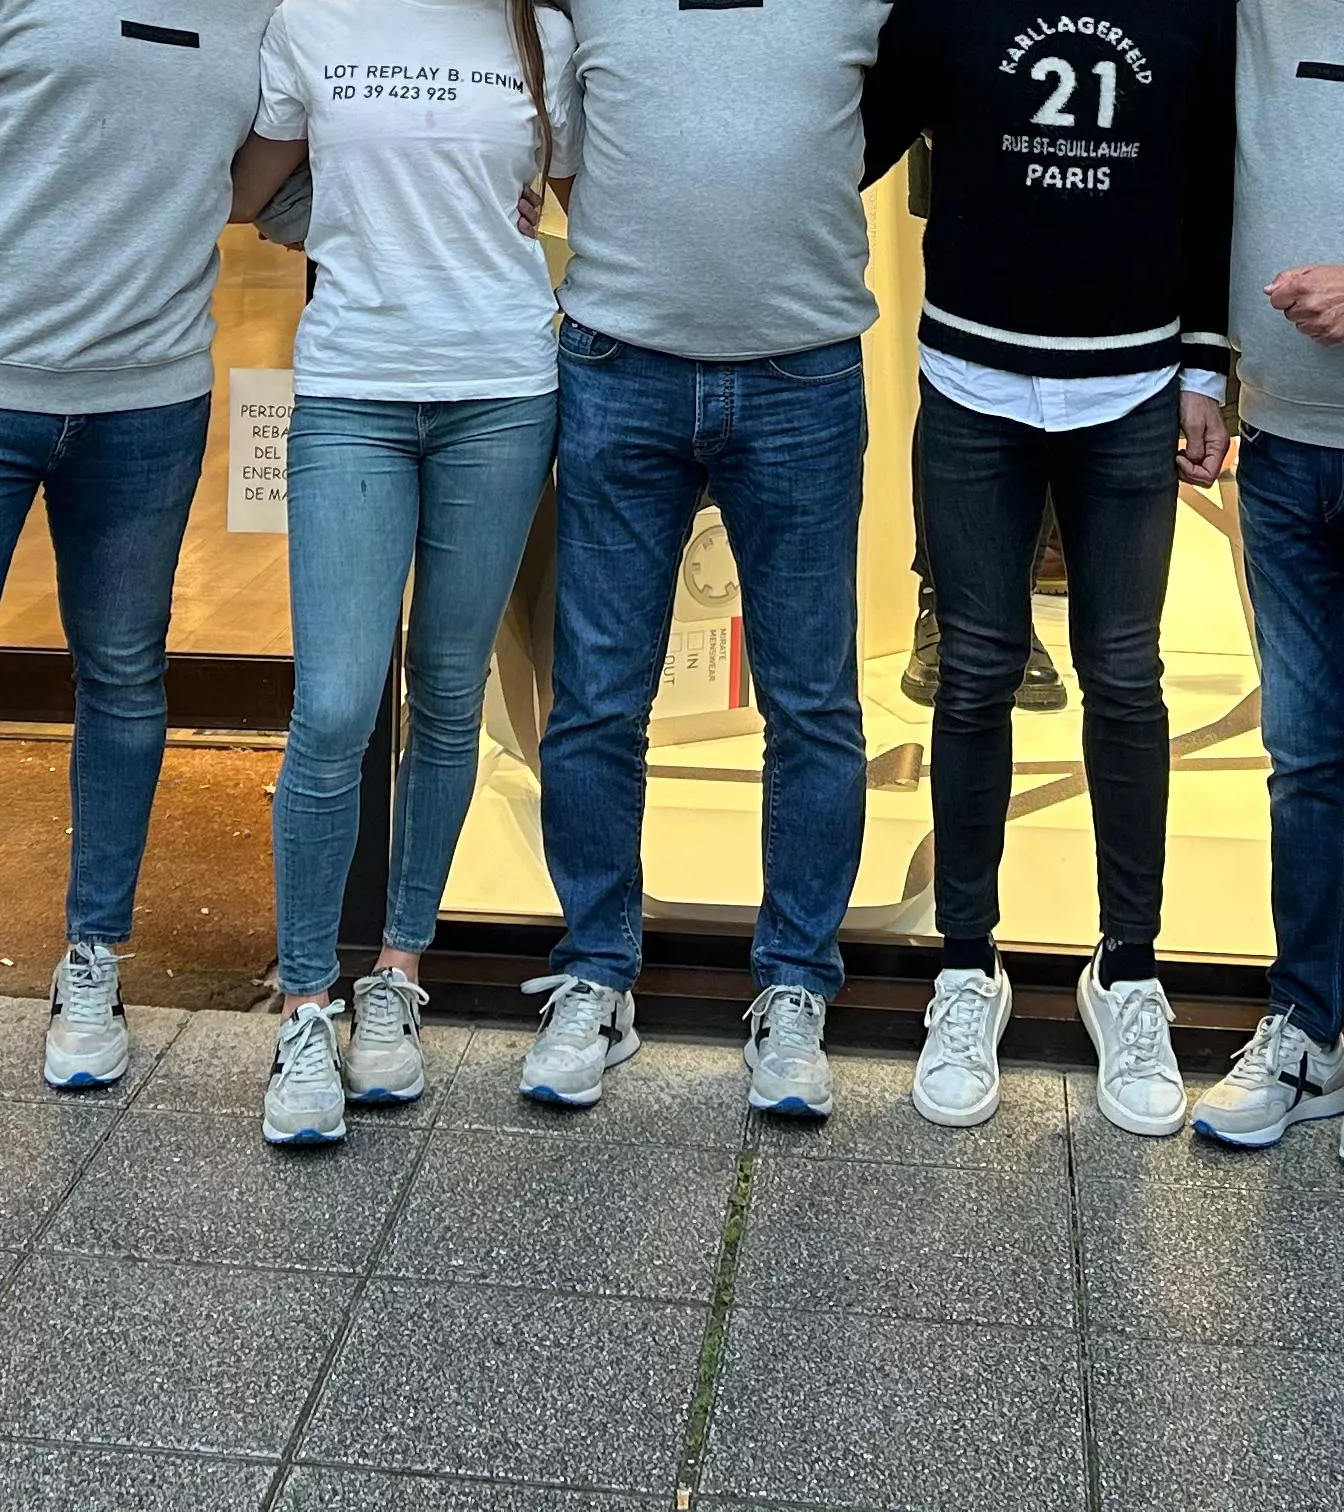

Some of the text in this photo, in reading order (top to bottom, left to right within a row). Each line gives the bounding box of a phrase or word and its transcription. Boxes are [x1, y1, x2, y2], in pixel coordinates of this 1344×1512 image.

[324, 64, 358, 80] LOT
[366, 65, 440, 81] REPLAY
[471, 71, 524, 94] DENIM
[332, 85, 457, 101] RD 39 423 925
[1029, 56, 1117, 129] 21
[1002, 134, 1030, 153] RUE
[1025, 163, 1111, 190] PARIS
[254, 446, 281, 460] DEL
[244, 487, 264, 500] DE
[663, 654, 676, 687] OUT
[687, 653, 699, 670] IN
